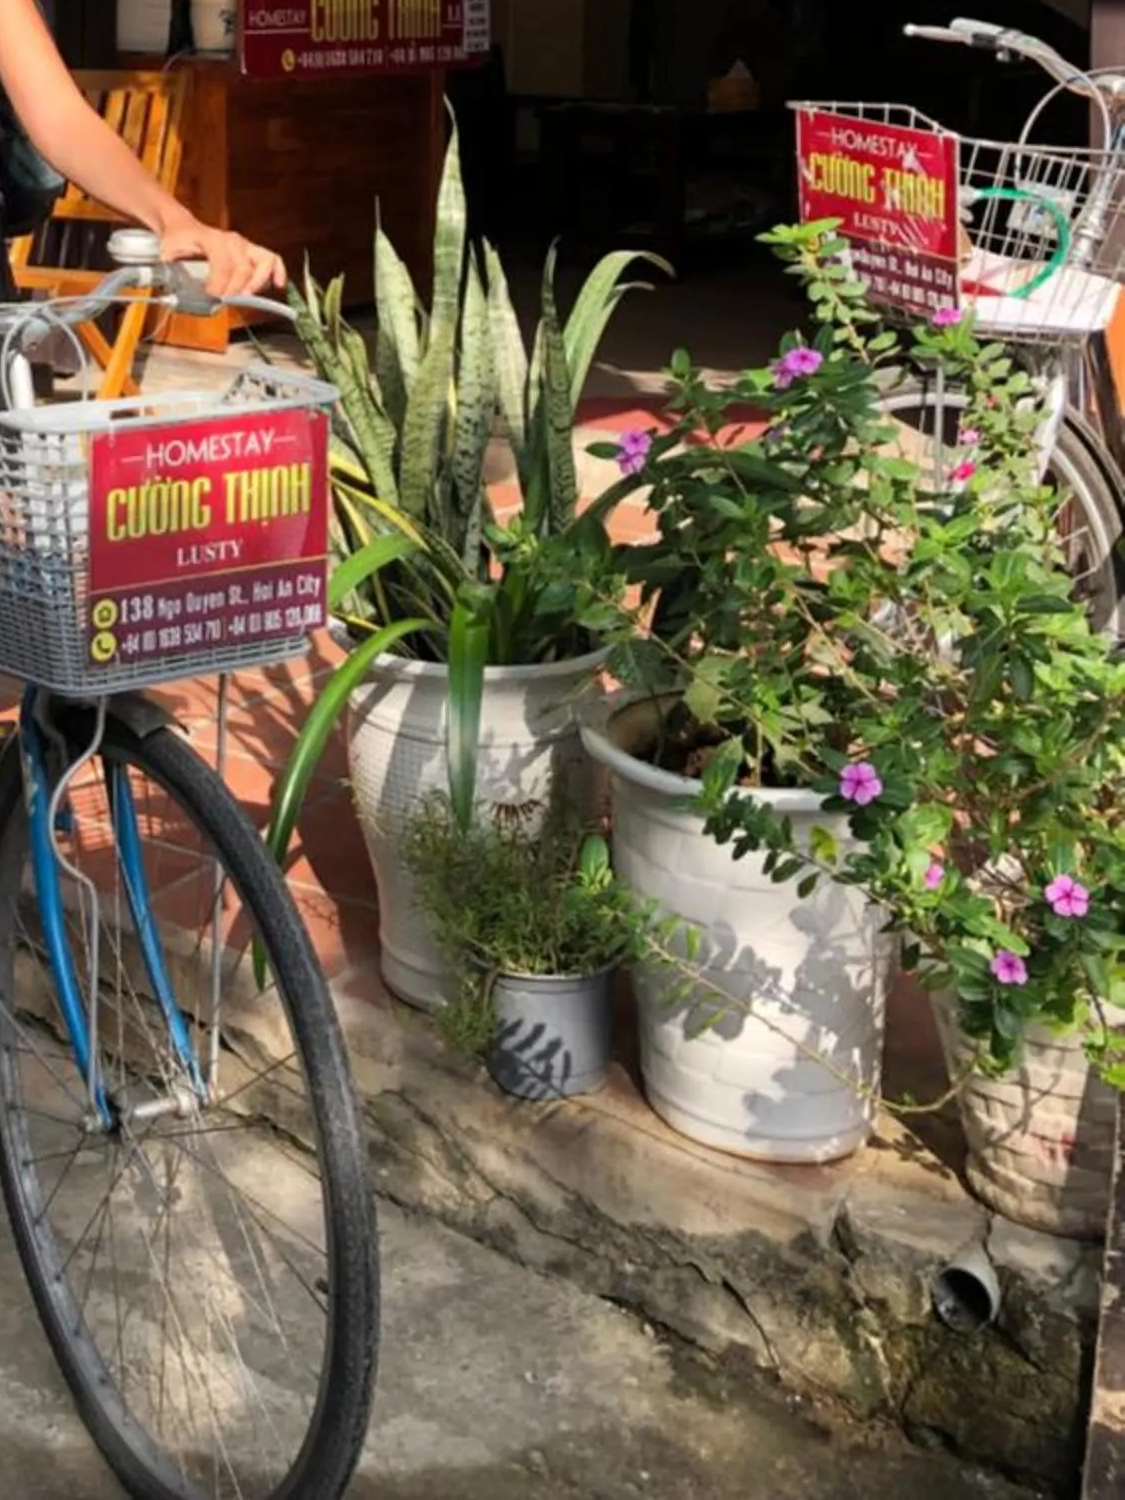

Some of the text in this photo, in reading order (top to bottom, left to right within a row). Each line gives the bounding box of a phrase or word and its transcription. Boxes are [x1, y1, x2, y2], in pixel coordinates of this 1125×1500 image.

[247, 8, 306, 27] HOMESTAY
[831, 127, 917, 159] HOMESTAY
[146, 428, 275, 468] HOMESTAY
[177, 539, 243, 566] LUSTY
[121, 594, 154, 623] 138
[297, 573, 321, 597] City
